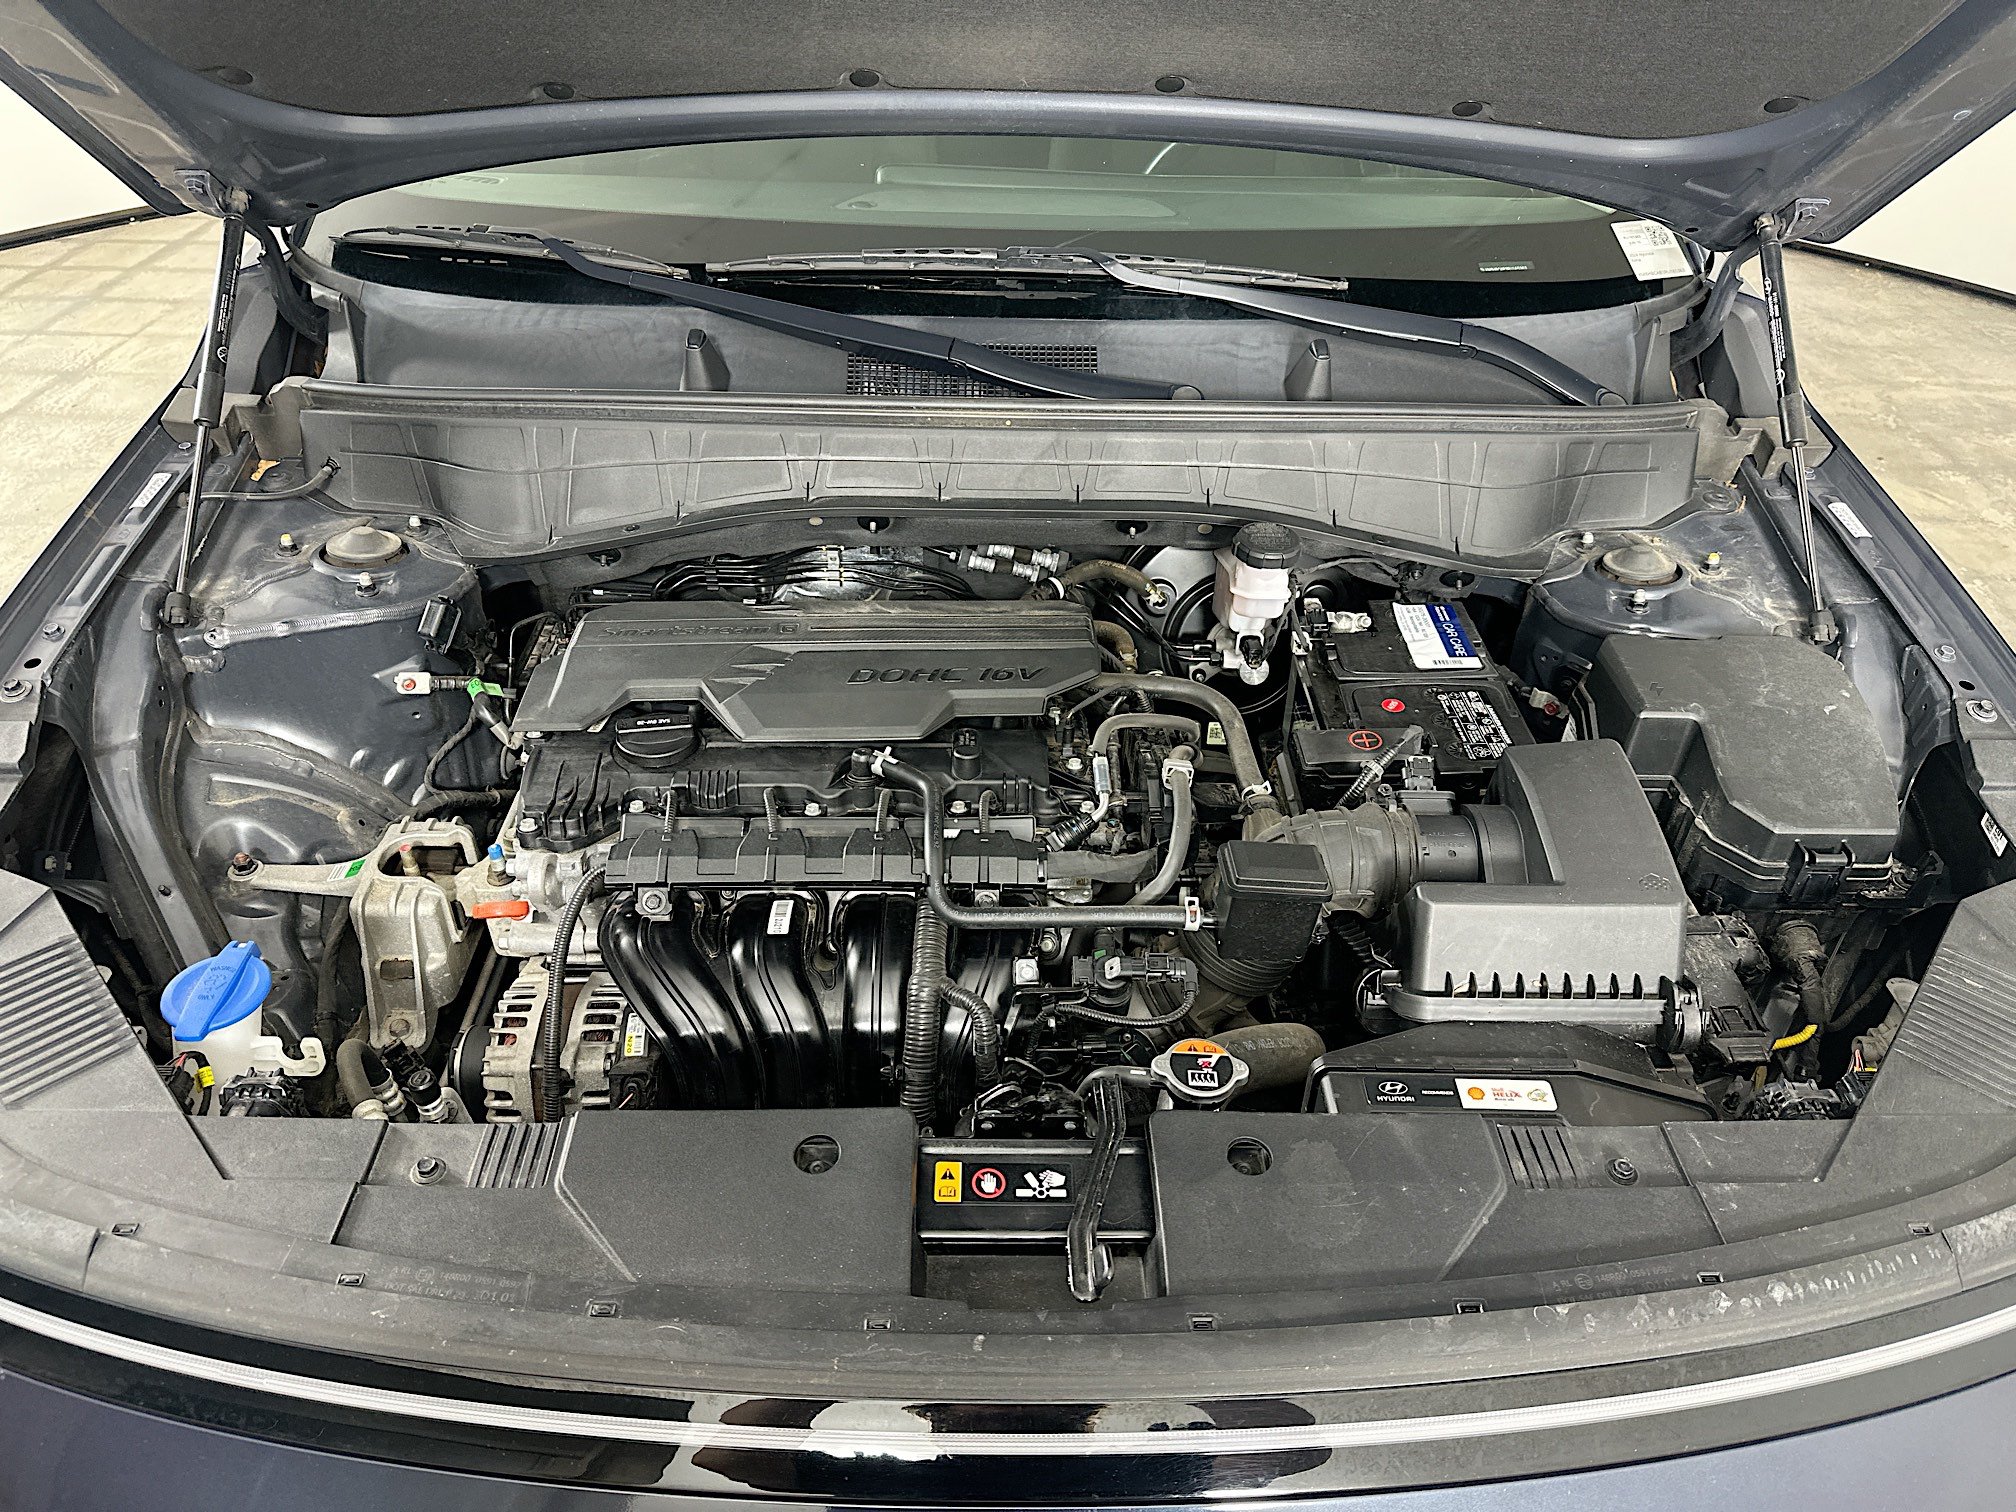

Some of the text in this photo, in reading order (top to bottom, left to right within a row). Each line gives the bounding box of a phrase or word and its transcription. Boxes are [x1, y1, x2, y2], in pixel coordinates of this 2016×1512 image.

[600, 624, 771, 640] Smartstream
[1441, 621, 1457, 638] CAR
[1449, 636, 1468, 657] CARE
[846, 665, 1052, 685] DOHC 16V
[1376, 1095, 1416, 1103] HYUNDAI
[1492, 1090, 1522, 1098] HELIX
